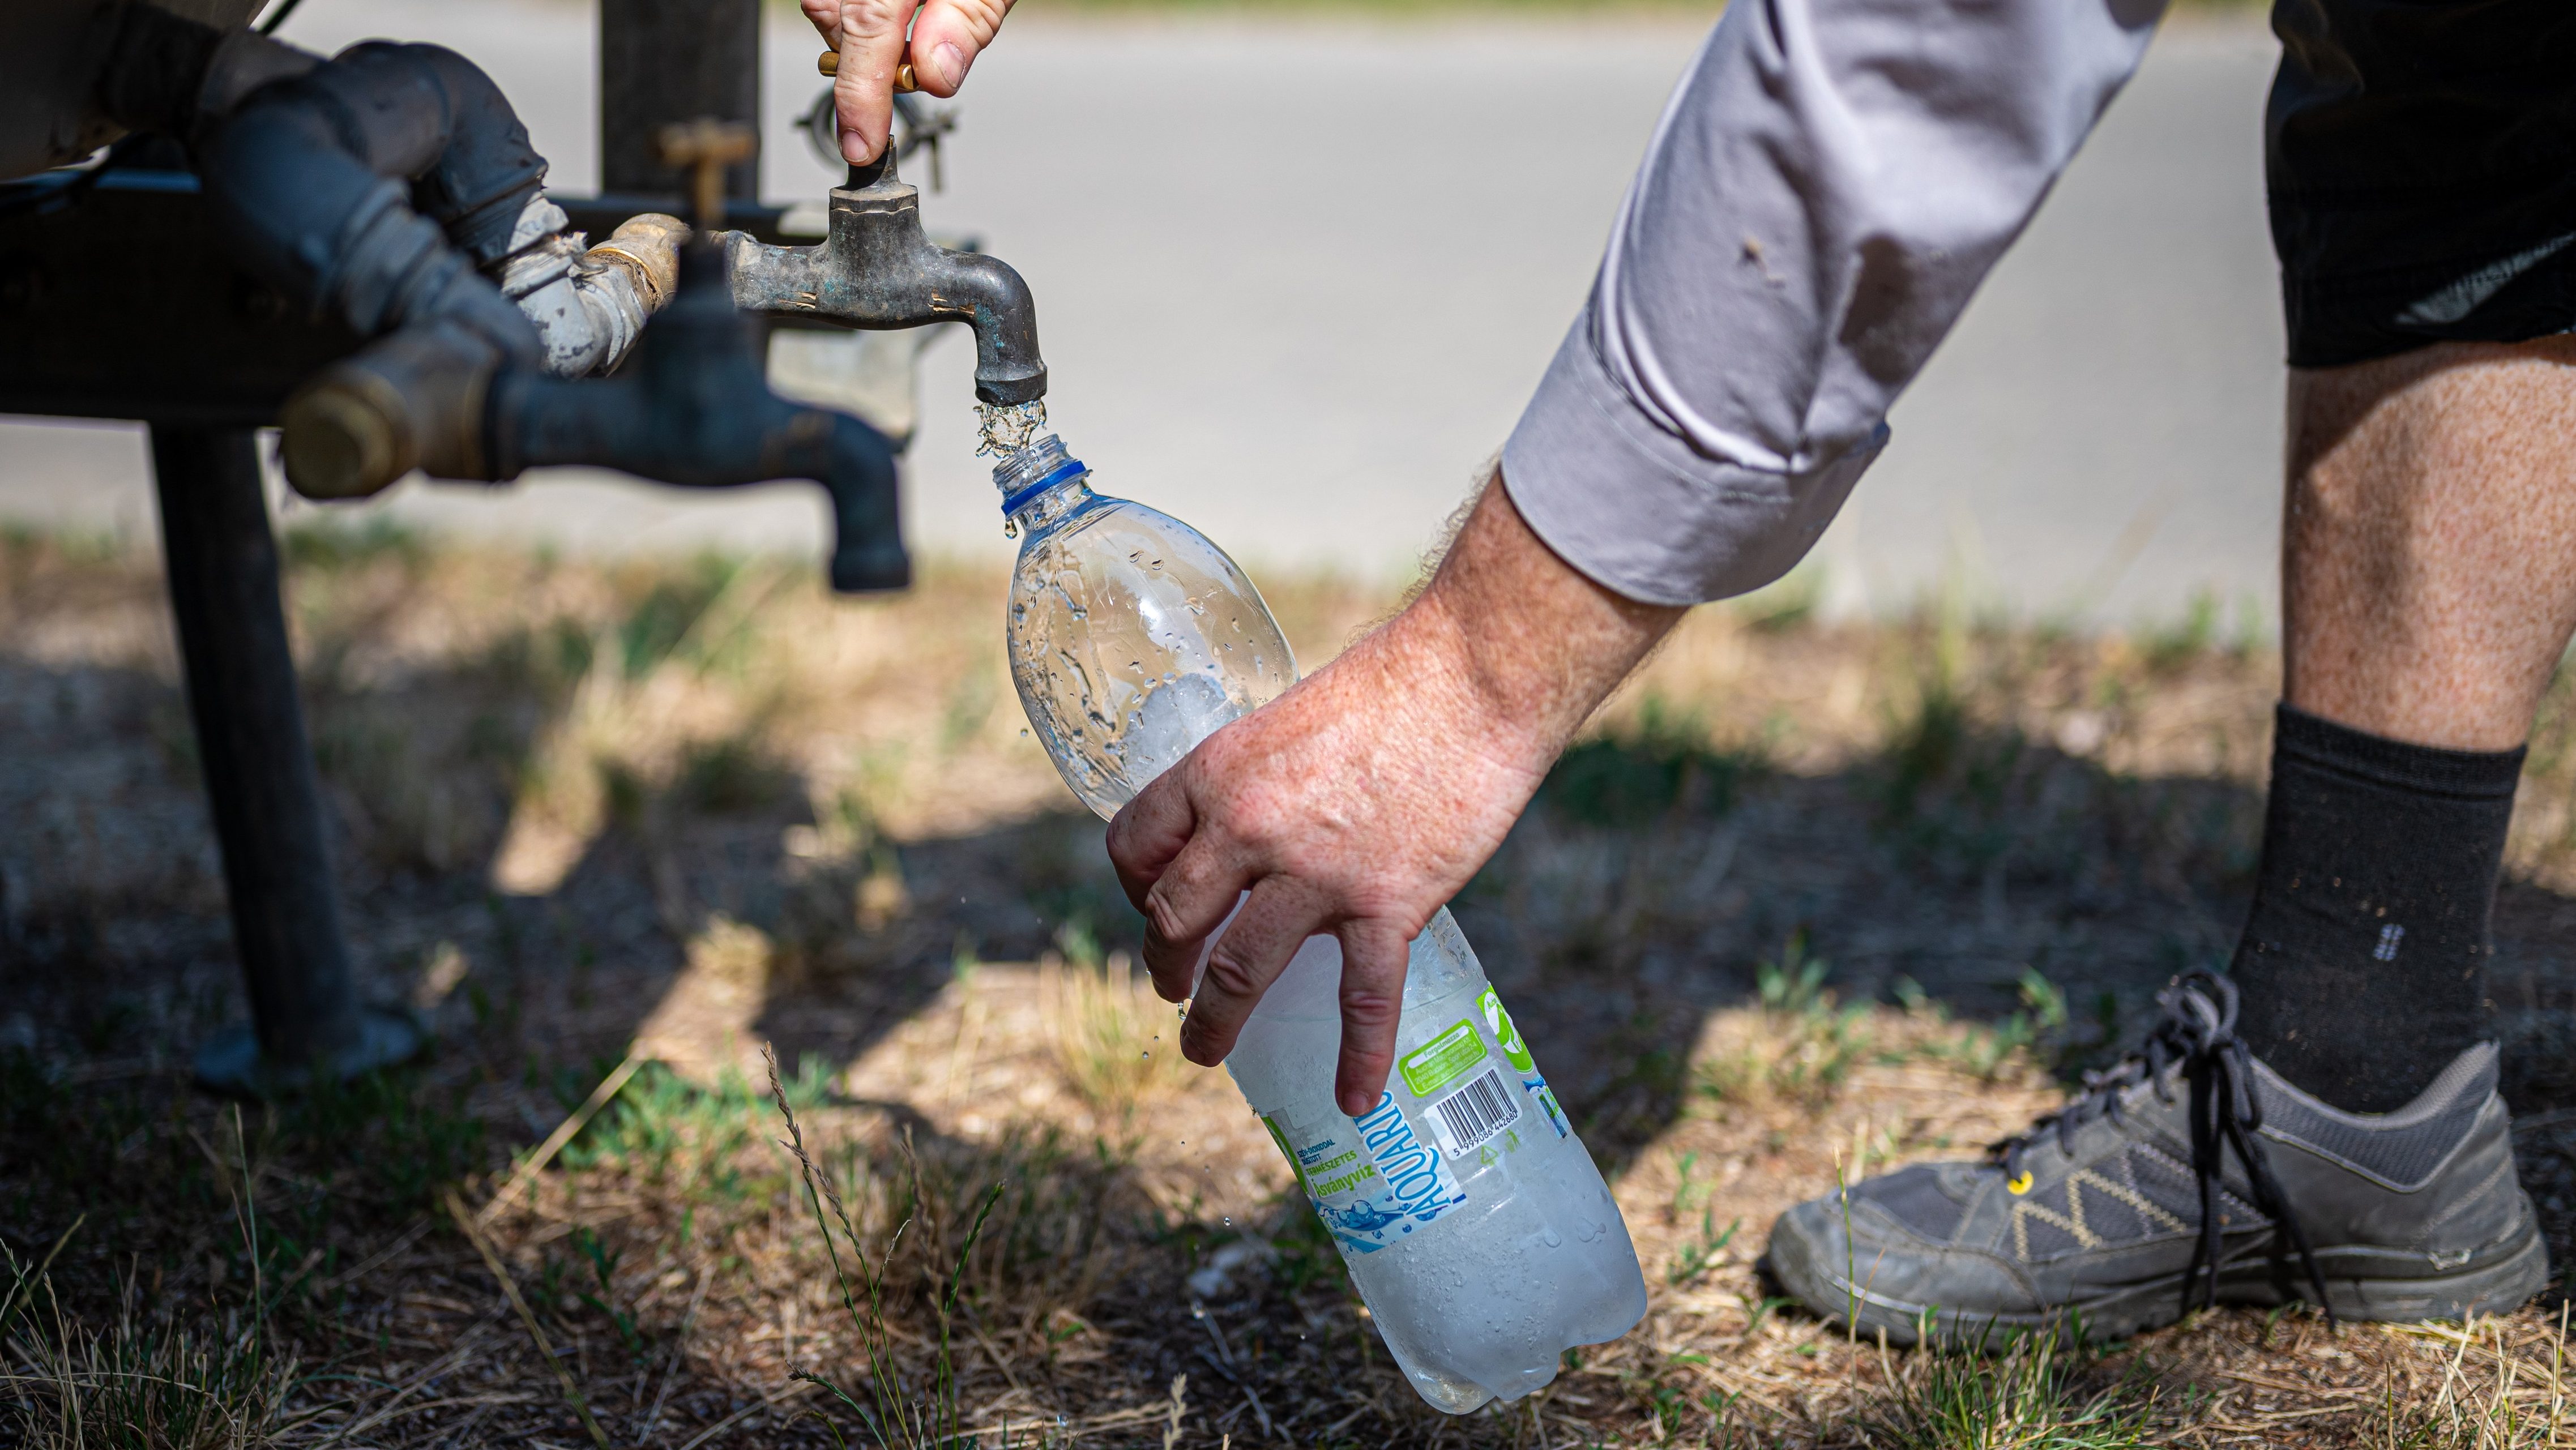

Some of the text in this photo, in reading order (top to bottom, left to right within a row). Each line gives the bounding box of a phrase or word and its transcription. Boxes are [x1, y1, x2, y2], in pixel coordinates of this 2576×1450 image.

[1424, 1032, 1460, 1058] Forgalmazza
[1414, 1071, 1429, 1085] 2040
[1453, 1110, 1518, 1156] 5 999086 442680
[1306, 1150, 1357, 1177] TERMÉSZETES
[1311, 1162, 1377, 1197] Ásványvíz
